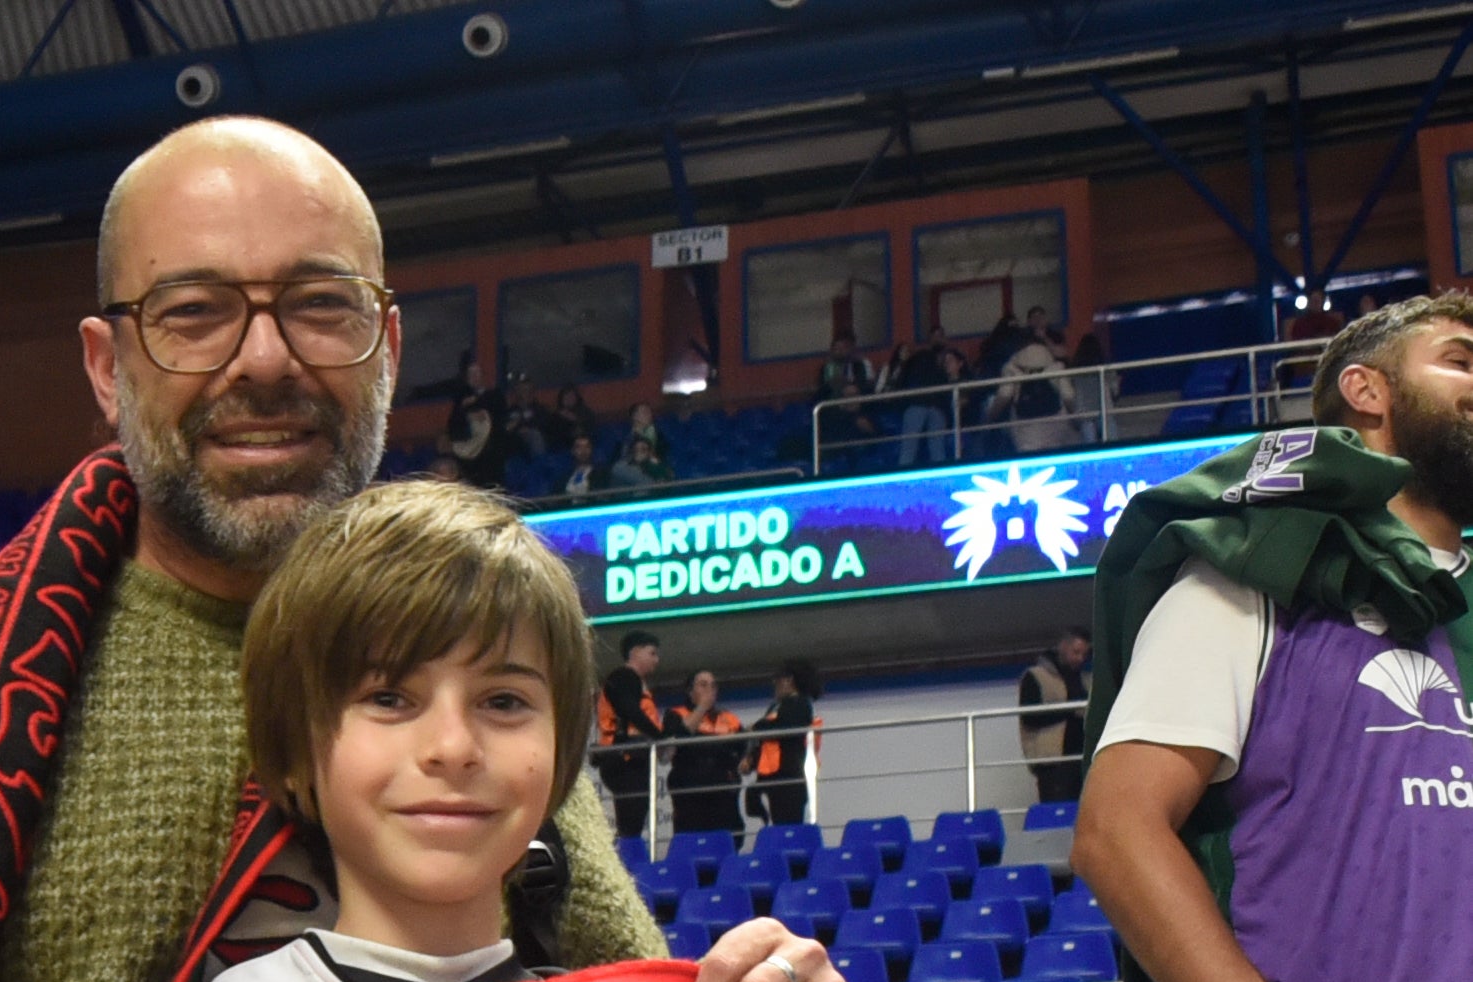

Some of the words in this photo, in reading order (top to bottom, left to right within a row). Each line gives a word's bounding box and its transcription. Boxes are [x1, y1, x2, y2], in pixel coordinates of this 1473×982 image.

[677, 245, 702, 261] B1
[607, 506, 788, 561] PARTIDO
[607, 545, 823, 603] DEDICADO
[832, 541, 865, 579] A
